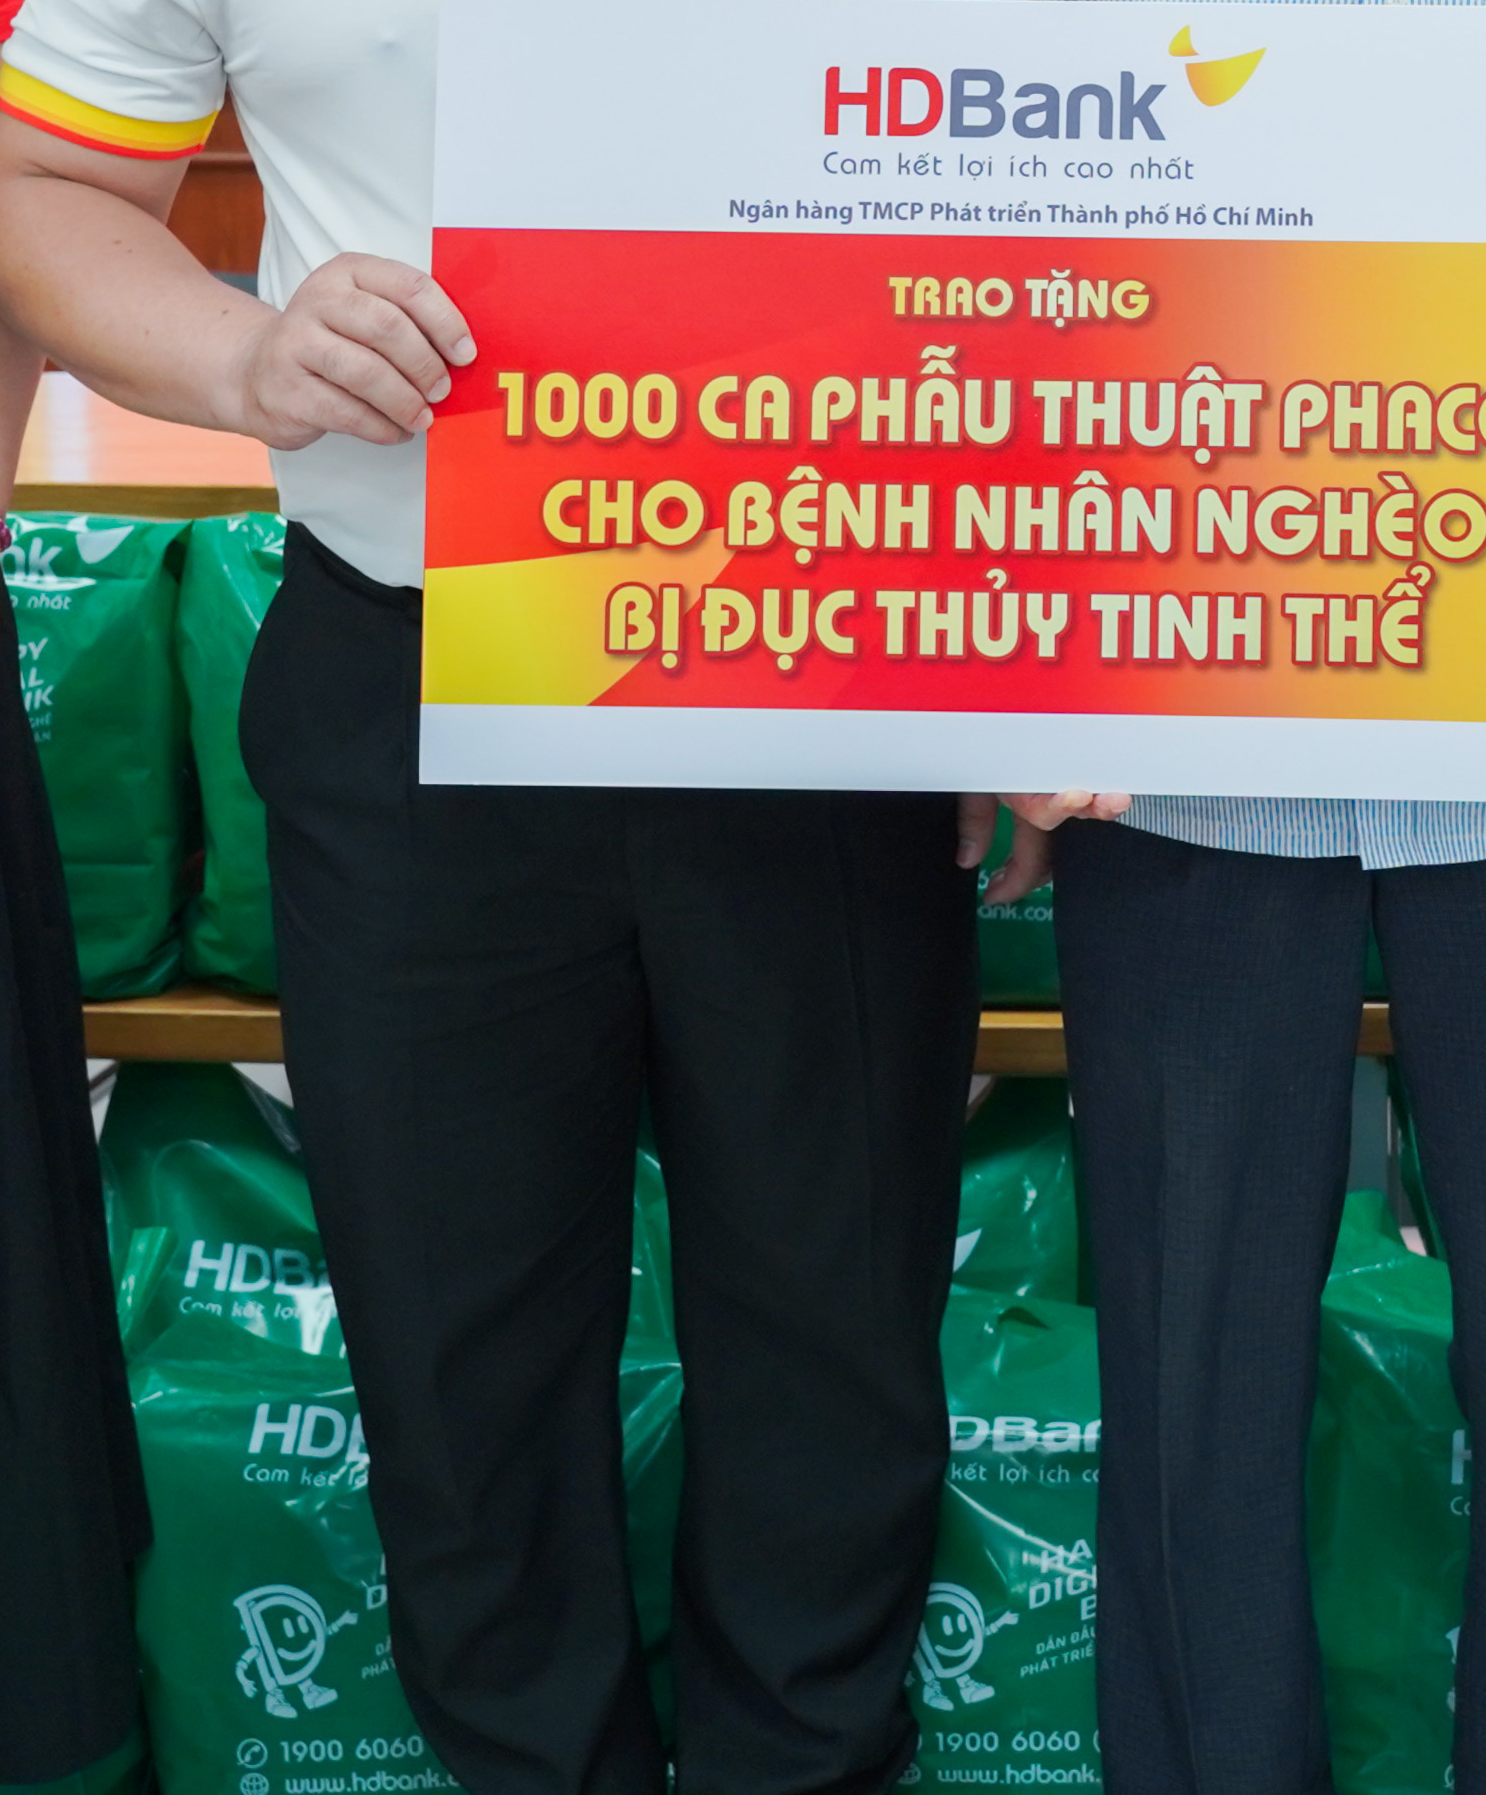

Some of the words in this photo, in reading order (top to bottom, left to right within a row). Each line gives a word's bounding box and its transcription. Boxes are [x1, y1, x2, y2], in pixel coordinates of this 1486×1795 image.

[824, 66, 1168, 141] HDBank
[823, 151, 881, 175] Cam
[898, 151, 943, 176] kết
[959, 154, 993, 181] lợi
[1010, 155, 1047, 177] ích
[1064, 161, 1114, 179] cao
[1130, 156, 1195, 180] nhất
[729, 199, 789, 223] Ngân
[795, 200, 853, 224] hàng
[859, 201, 924, 221] TMCP
[930, 201, 982, 223] Phát
[987, 199, 1042, 224] triển
[1046, 202, 1118, 224] Thành
[1124, 202, 1170, 229] phố
[1176, 202, 1206, 225] Hồ
[1212, 202, 1250, 226] Chí
[1256, 204, 1314, 227] Minh
[888, 276, 1014, 317] TRAO
[1024, 268, 1151, 329] TẶNG
[498, 372, 677, 439] 1000
[698, 375, 790, 440] CA
[811, 345, 1012, 445] PHẪU
[1033, 365, 1263, 465] THUẬT
[542, 479, 705, 547] CHO
[728, 465, 931, 565] BỆNH
[955, 470, 1173, 555] NHÂN
[608, 585, 680, 670] BỊ
[701, 587, 855, 671] ĐỤC
[875, 568, 1069, 659] THỦY
[1090, 592, 1263, 662] TINH
[1283, 565, 1432, 665] THỂ
[243, 1463, 290, 1483] Cam
[951, 1461, 988, 1482] kết
[280, 1739, 344, 1763] 1900
[355, 1735, 425, 1761] 6060
[935, 1731, 999, 1752] 1900
[1012, 1730, 1081, 1752] 6060
[937, 1762, 1102, 1784] www.hdbank.
